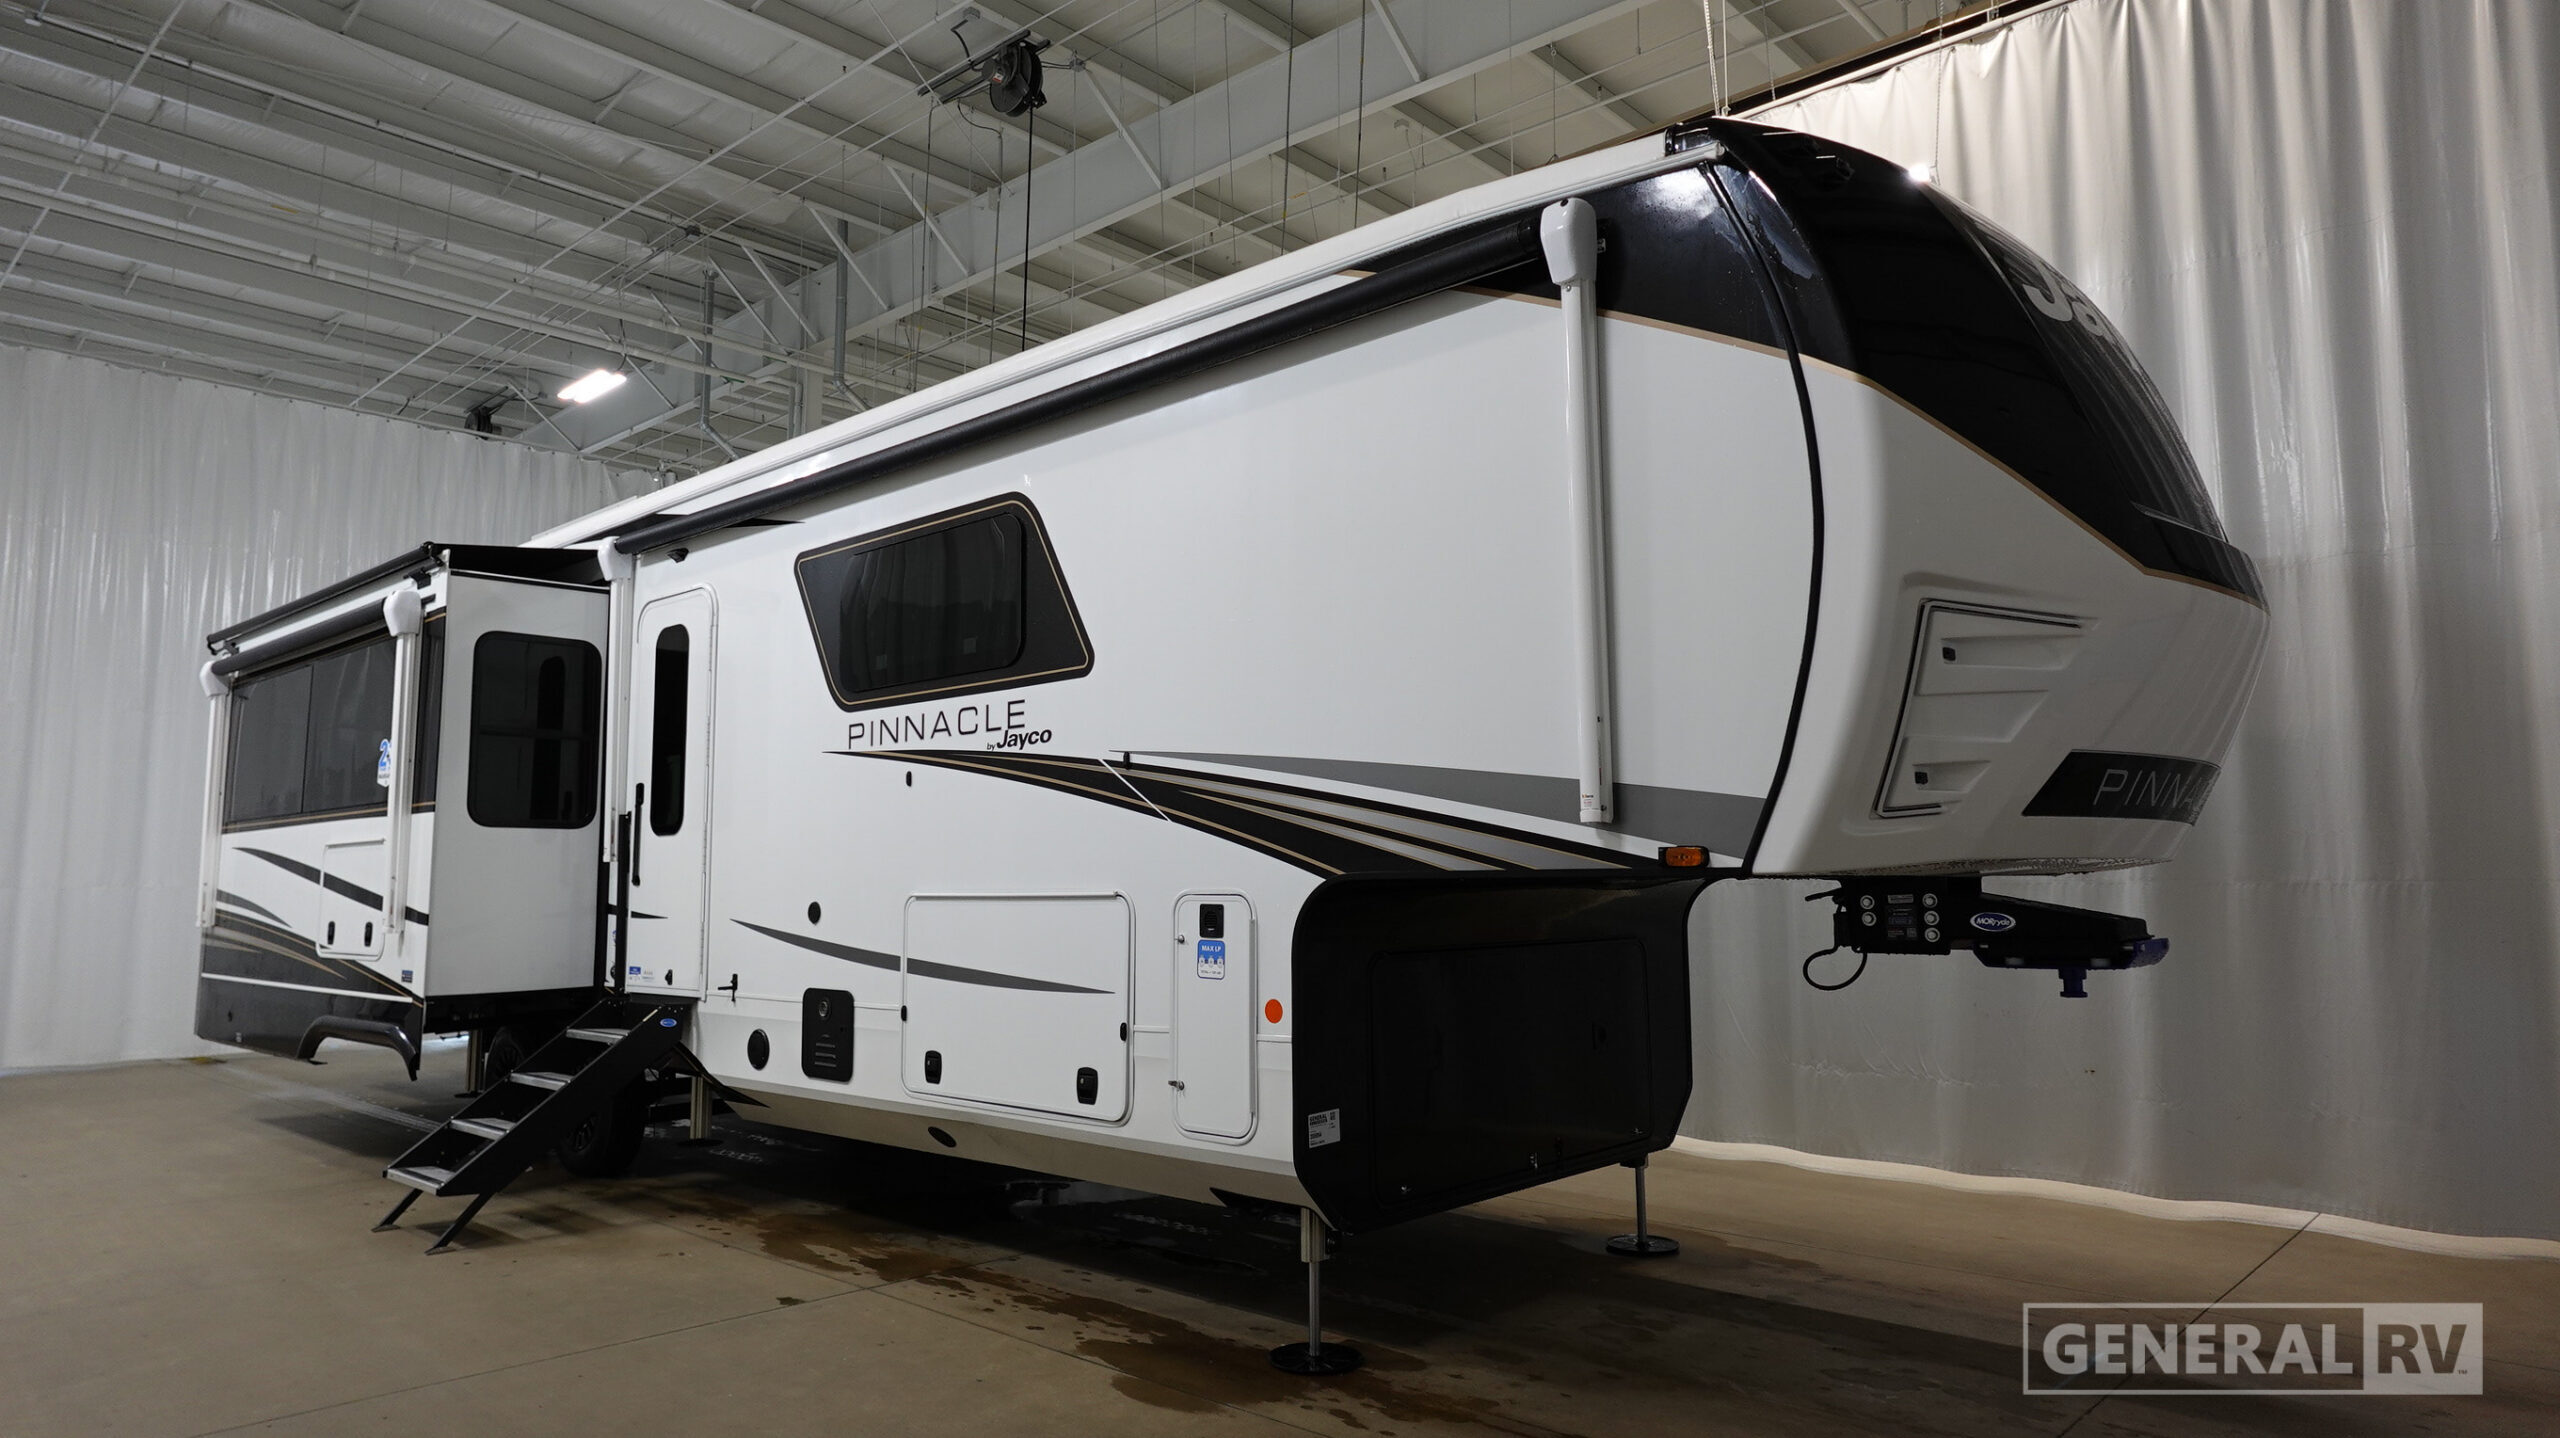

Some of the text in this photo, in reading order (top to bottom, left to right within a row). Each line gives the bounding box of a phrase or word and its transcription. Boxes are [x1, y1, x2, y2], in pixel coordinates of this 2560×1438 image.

[848, 699, 1026, 750] PINNACLE
[986, 729, 1053, 751] by Jayco
[1201, 944, 1215, 952] MAX
